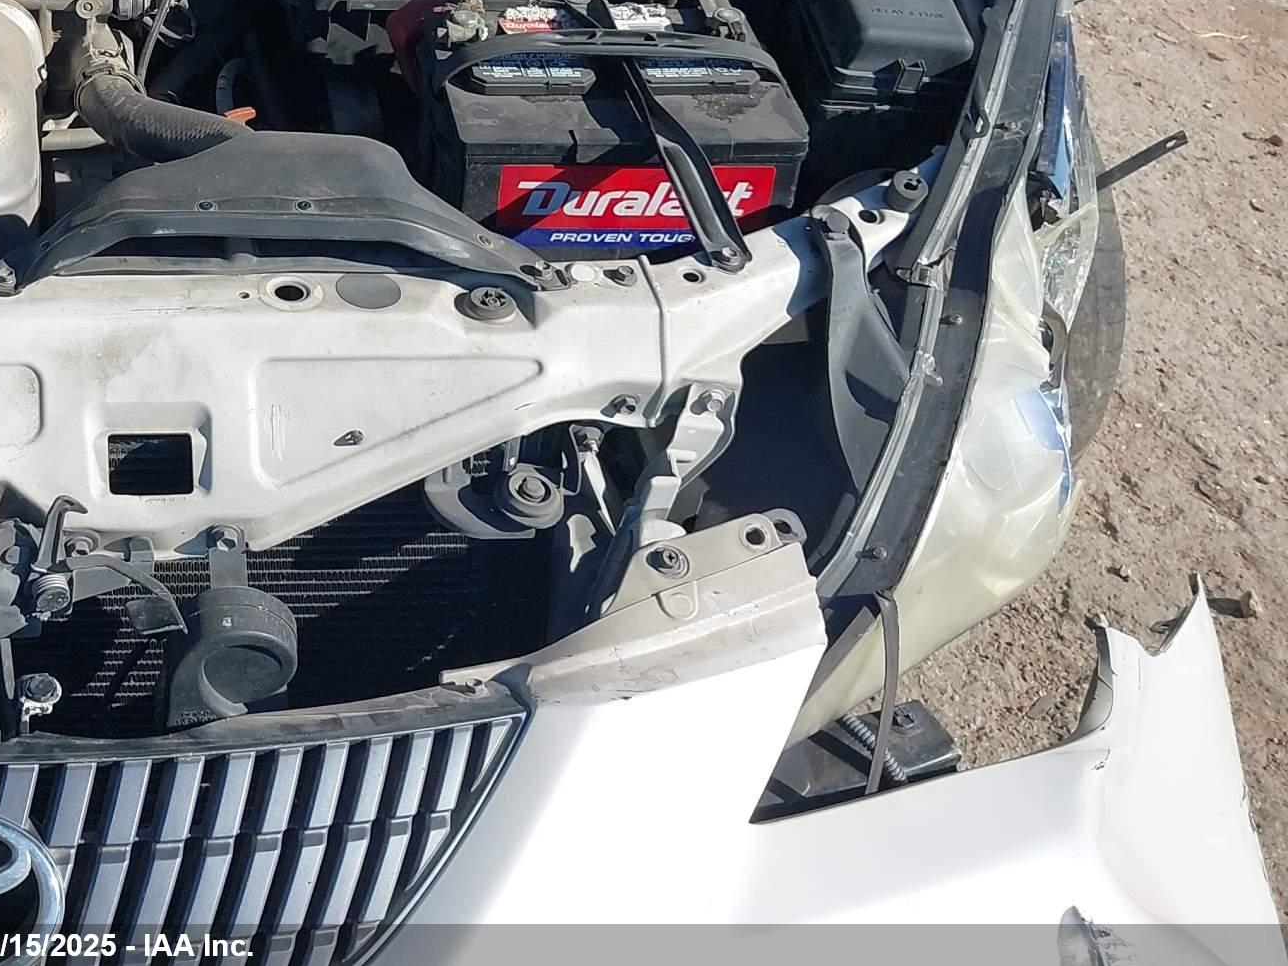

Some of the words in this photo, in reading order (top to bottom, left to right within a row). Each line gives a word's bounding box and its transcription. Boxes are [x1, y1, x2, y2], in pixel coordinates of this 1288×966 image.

[517, 181, 754, 217] Duralat
[549, 233, 633, 244] PROVEN
[639, 233, 696, 244] TOUG
